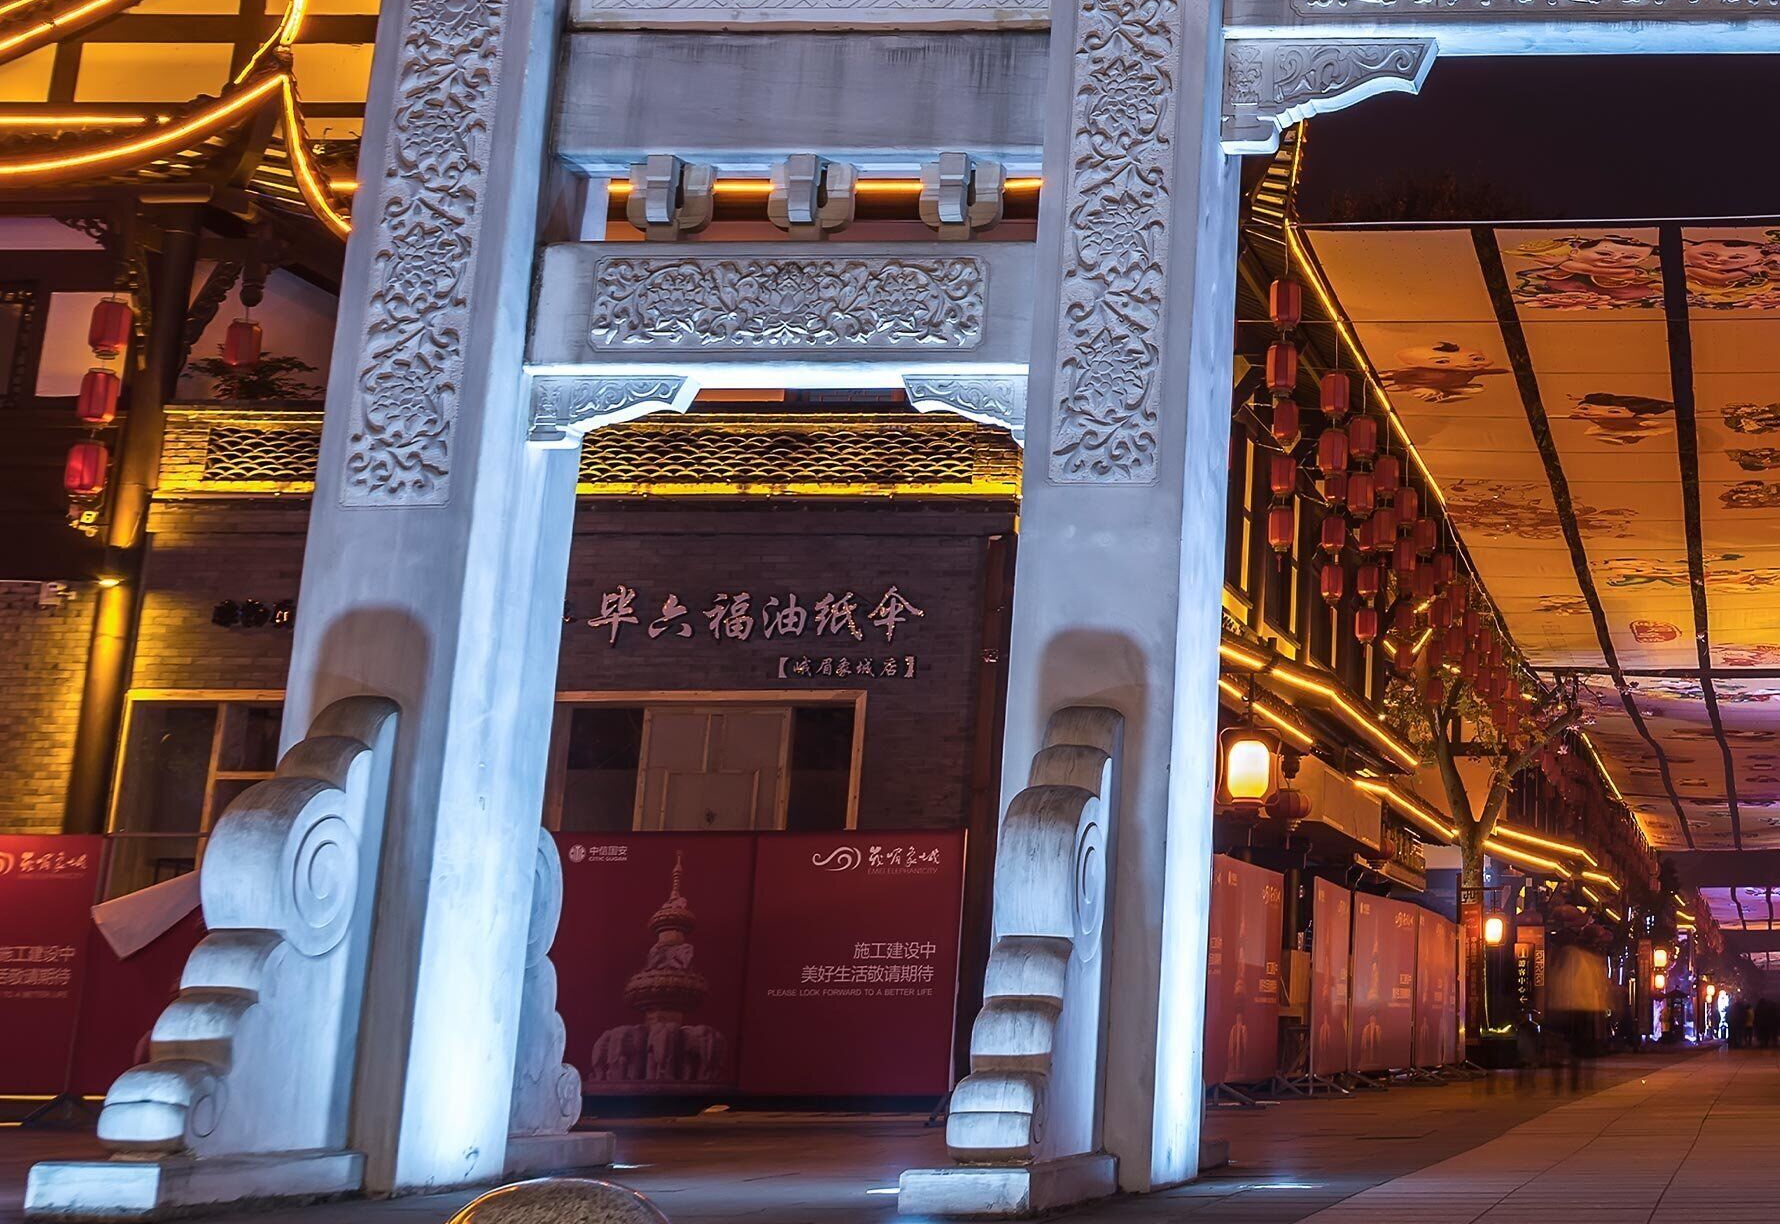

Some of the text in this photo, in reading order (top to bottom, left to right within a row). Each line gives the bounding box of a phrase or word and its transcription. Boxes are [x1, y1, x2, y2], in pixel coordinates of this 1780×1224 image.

[589, 846, 628, 856] 中信国安
[853, 942, 936, 960] 施工建设中
[801, 964, 934, 984] 美好生活敬请期待
[767, 988, 933, 997] PLEASE LOOK FORWARD TO A BETTER LIFE
